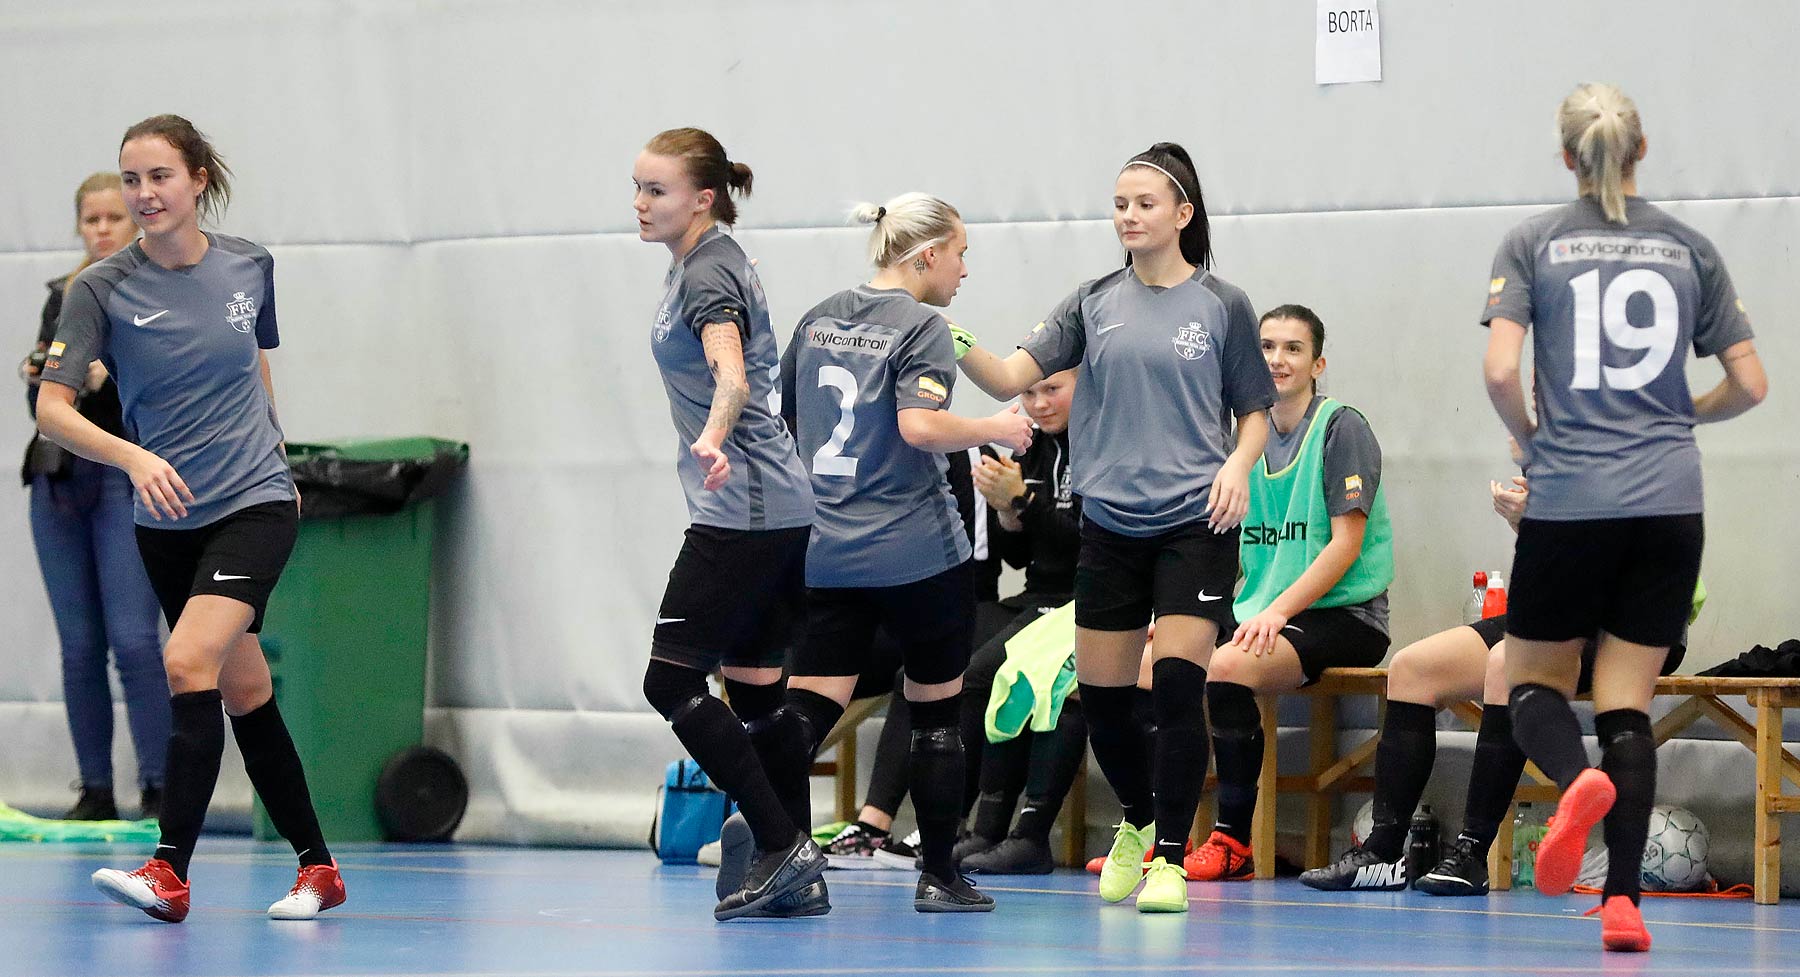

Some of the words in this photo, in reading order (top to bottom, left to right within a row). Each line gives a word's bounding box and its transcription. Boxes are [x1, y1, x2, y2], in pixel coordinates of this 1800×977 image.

[1328, 9, 1373, 33] BORTA
[1570, 242, 1681, 260] Kylcontroll
[230, 300, 255, 316] FFC
[812, 330, 888, 351] Kylcontroll
[1180, 329, 1206, 345] FFC
[1569, 268, 1679, 391] 19
[812, 365, 859, 477] 2
[1350, 855, 1407, 888] NIKE
